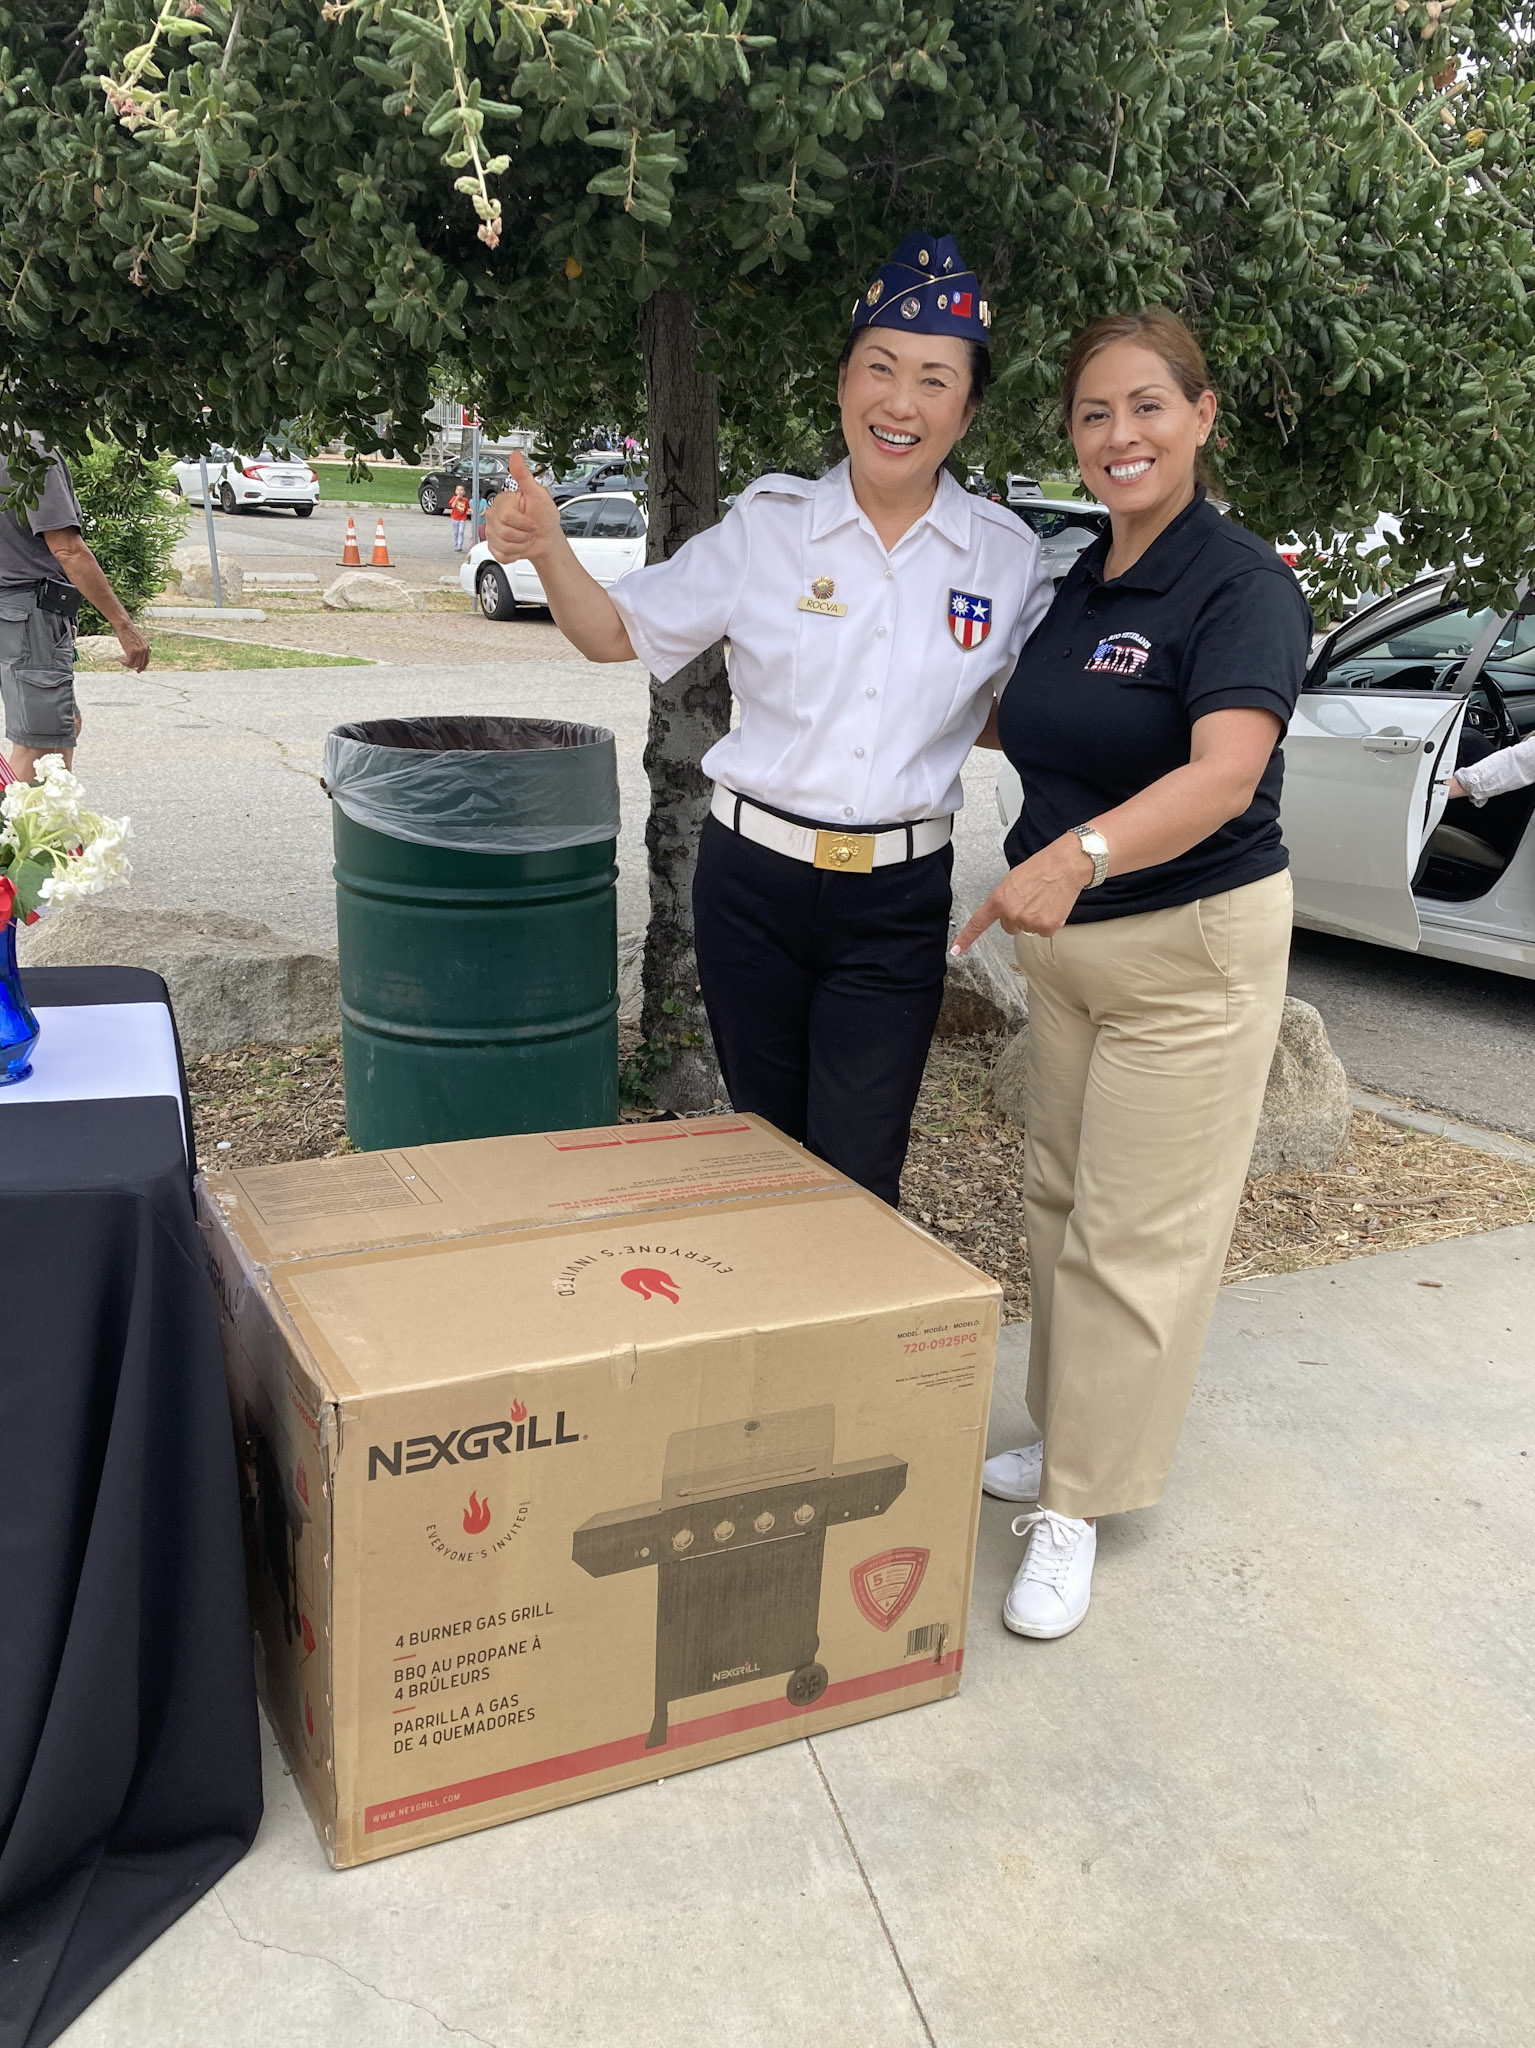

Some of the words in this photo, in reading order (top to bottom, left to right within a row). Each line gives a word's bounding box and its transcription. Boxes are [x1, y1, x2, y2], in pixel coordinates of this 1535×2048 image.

[806, 600, 838, 613] ROCVA
[1121, 632, 1152, 649] VETERANS
[600, 1245, 733, 1274] EVERYONE'S
[896, 1330, 918, 1339] MODEL
[904, 1332, 978, 1354] 720-0925PG
[368, 1410, 580, 1481] NEXGRILL
[426, 1524, 488, 1562] EVERYONE'S
[492, 1501, 531, 1552] INVITED!
[872, 1573, 884, 1586] 5
[395, 1635, 404, 1648] 4
[409, 1620, 472, 1646] BURNER
[476, 1612, 506, 1630] GAS
[511, 1602, 554, 1622] GRILL
[394, 1664, 426, 1683] BBQ
[431, 1658, 452, 1674] AU
[457, 1640, 528, 1668] PROPANE
[532, 1634, 542, 1651] À
[712, 1662, 761, 1682] NEXGRILL
[394, 1687, 404, 1700] 4
[409, 1667, 490, 1698] BRÛLEURS
[394, 1706, 470, 1736] PARRILLA
[475, 1702, 484, 1716] A
[490, 1694, 519, 1712] GAS
[394, 1738, 414, 1754] DE
[419, 1734, 427, 1747] 4
[433, 1708, 535, 1745] QUEMADORES
